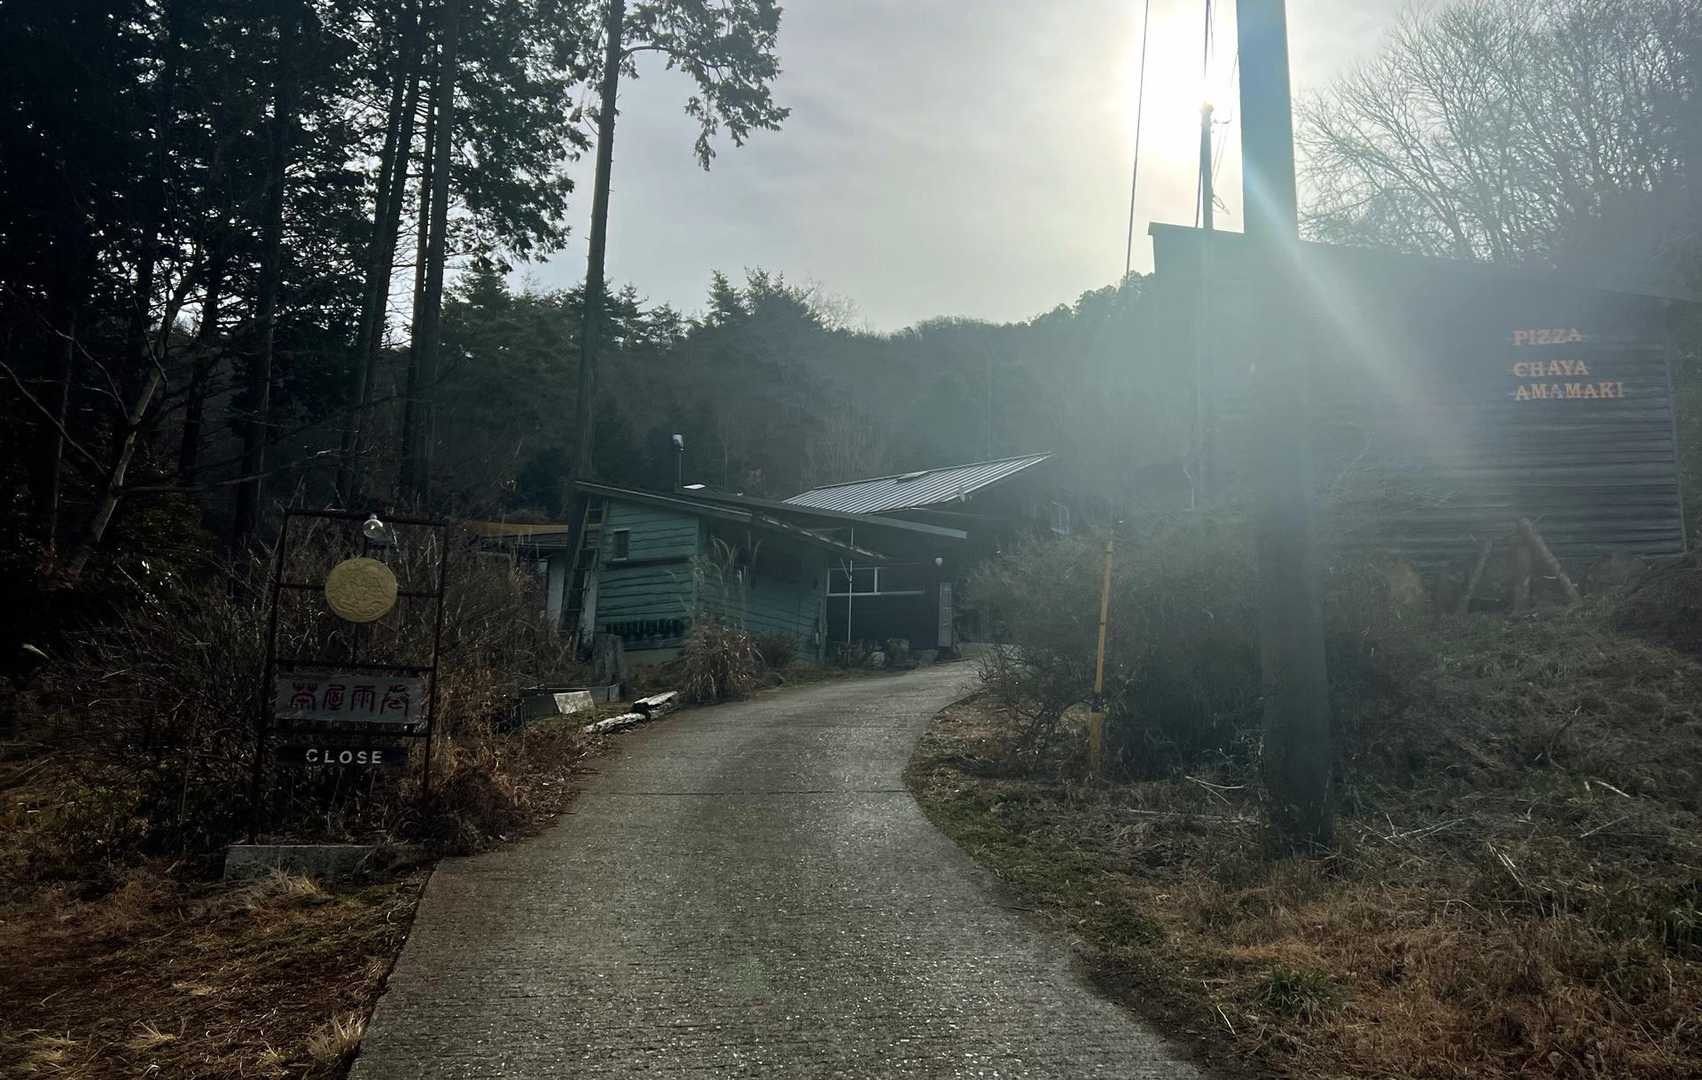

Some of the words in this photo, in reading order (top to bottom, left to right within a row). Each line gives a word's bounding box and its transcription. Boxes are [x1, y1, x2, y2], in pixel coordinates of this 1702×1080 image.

[1512, 327, 1583, 345] PIZZA
[1513, 360, 1590, 376] CHAYA
[1515, 382, 1624, 400] AMAMAKI
[305, 748, 383, 764] CLOSE
